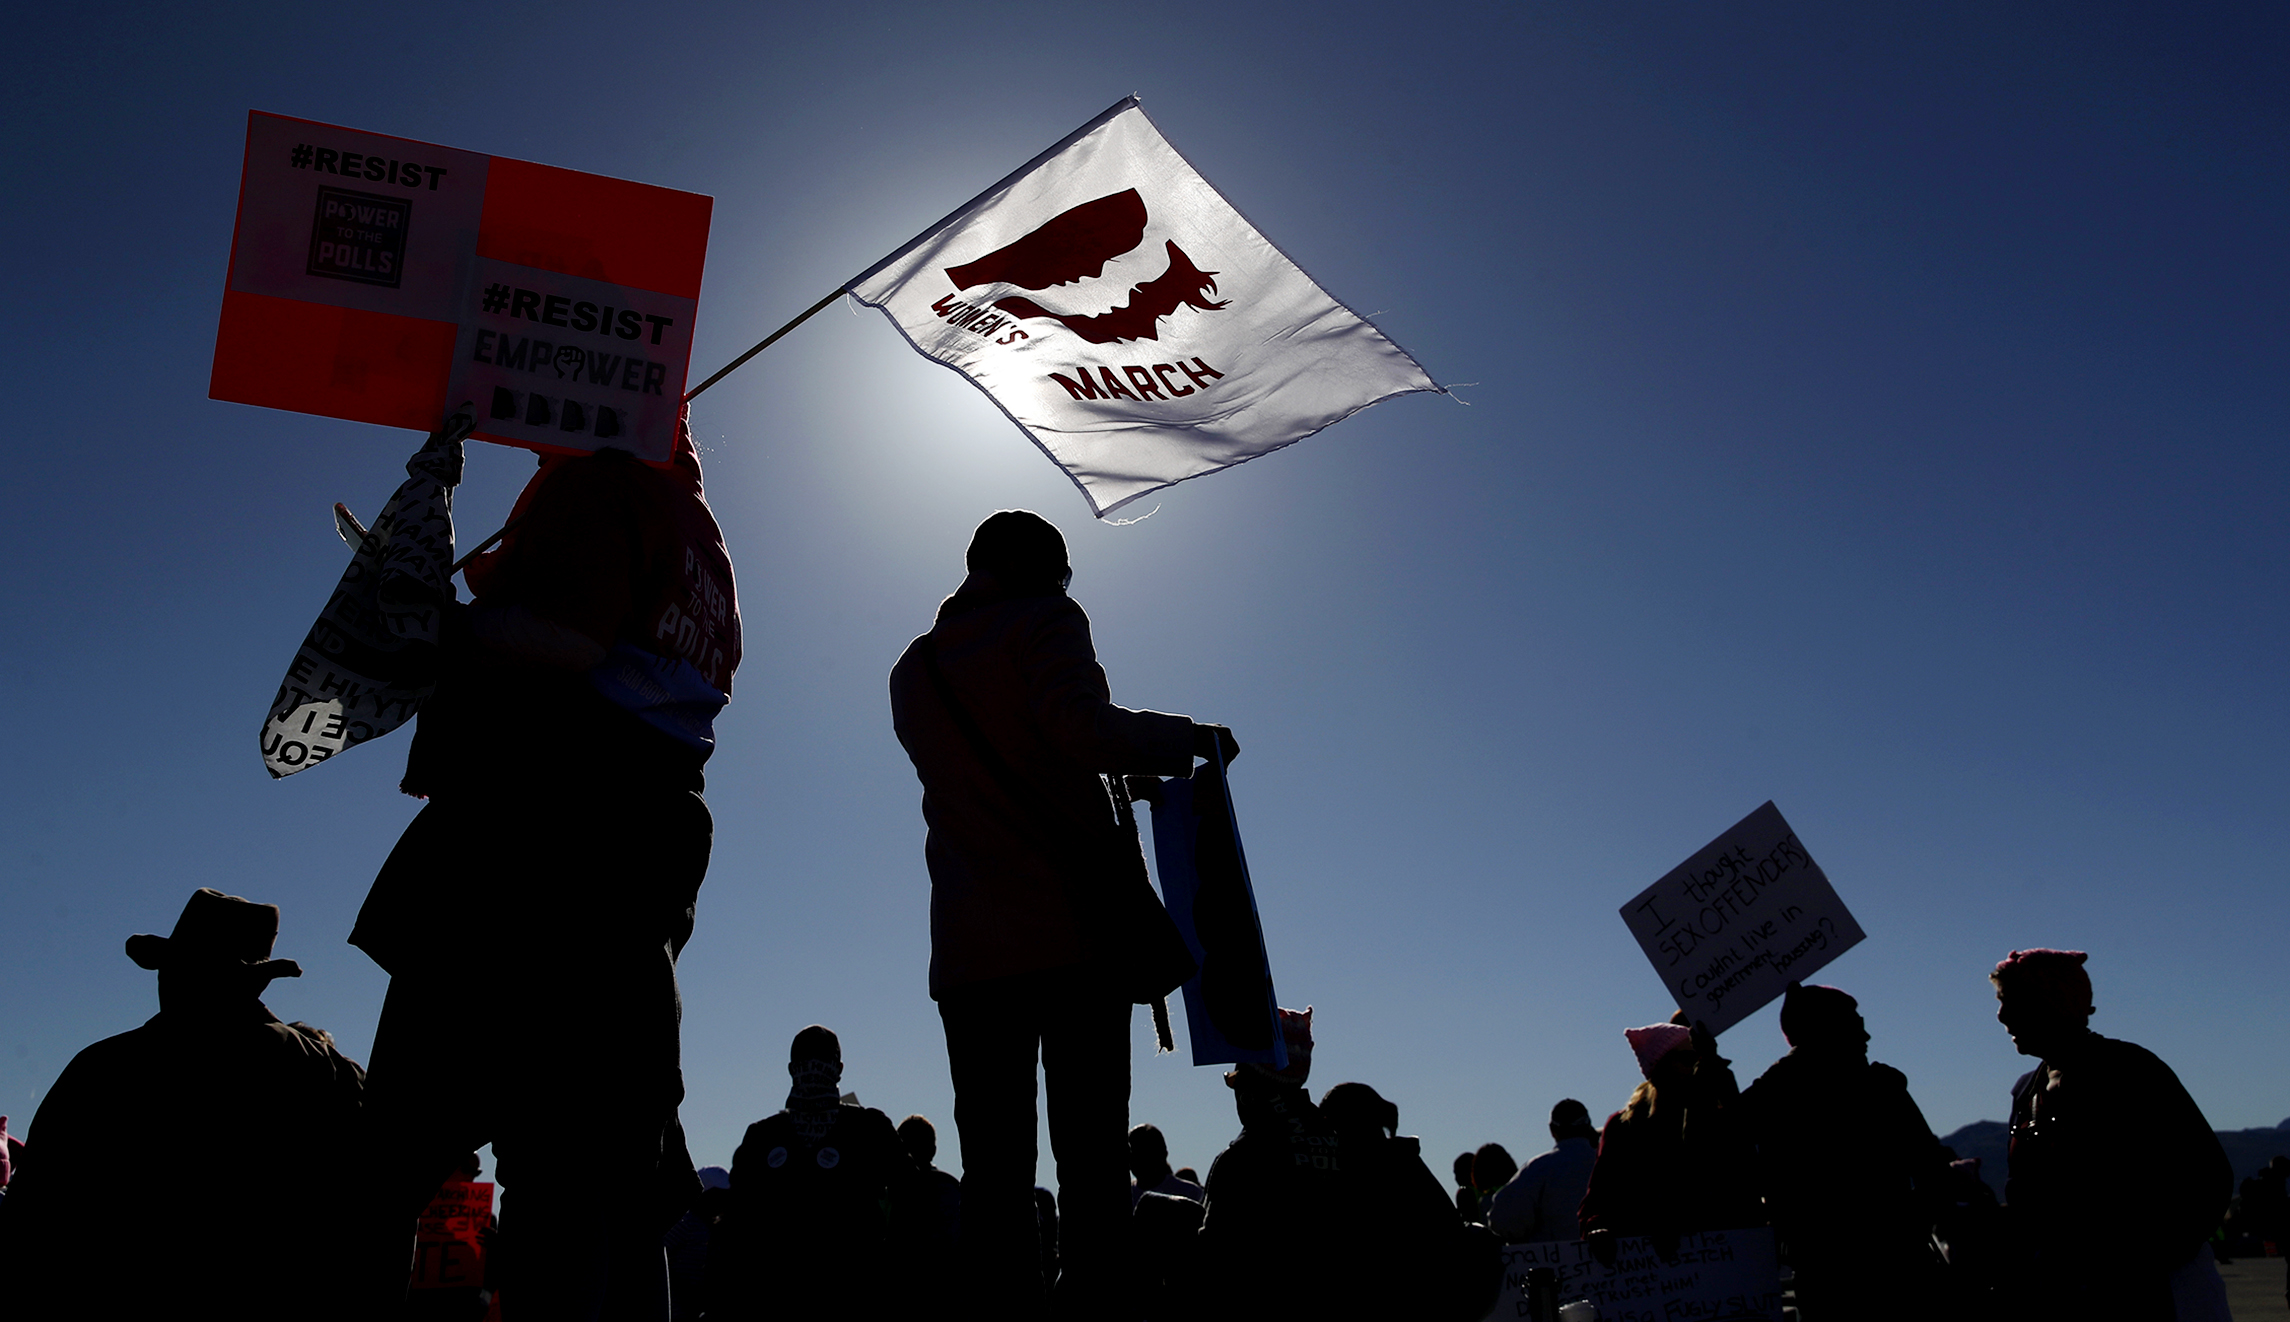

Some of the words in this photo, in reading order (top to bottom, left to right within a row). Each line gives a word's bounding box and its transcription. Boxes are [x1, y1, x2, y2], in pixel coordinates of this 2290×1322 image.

[290, 143, 447, 191] #RESIST
[325, 199, 401, 230] POWER
[336, 226, 355, 240] TO
[357, 229, 384, 244] THE
[318, 241, 394, 274] POLLS
[482, 283, 673, 346] #RESIST
[930, 293, 1029, 345] WOMEN'S
[1047, 356, 1225, 401] MARCH
[656, 602, 724, 685] POLLS
[1636, 894, 1677, 938] I
[1682, 844, 1755, 904] thought
[1658, 921, 1706, 967] SEX
[1698, 833, 1811, 936] OFFENDERS
[1740, 919, 1778, 952] live
[1778, 904, 1804, 924] in
[1293, 1153, 1342, 1172] POL
[1501, 1243, 1561, 1266] onald
[1570, 1235, 1652, 1260] TMP
